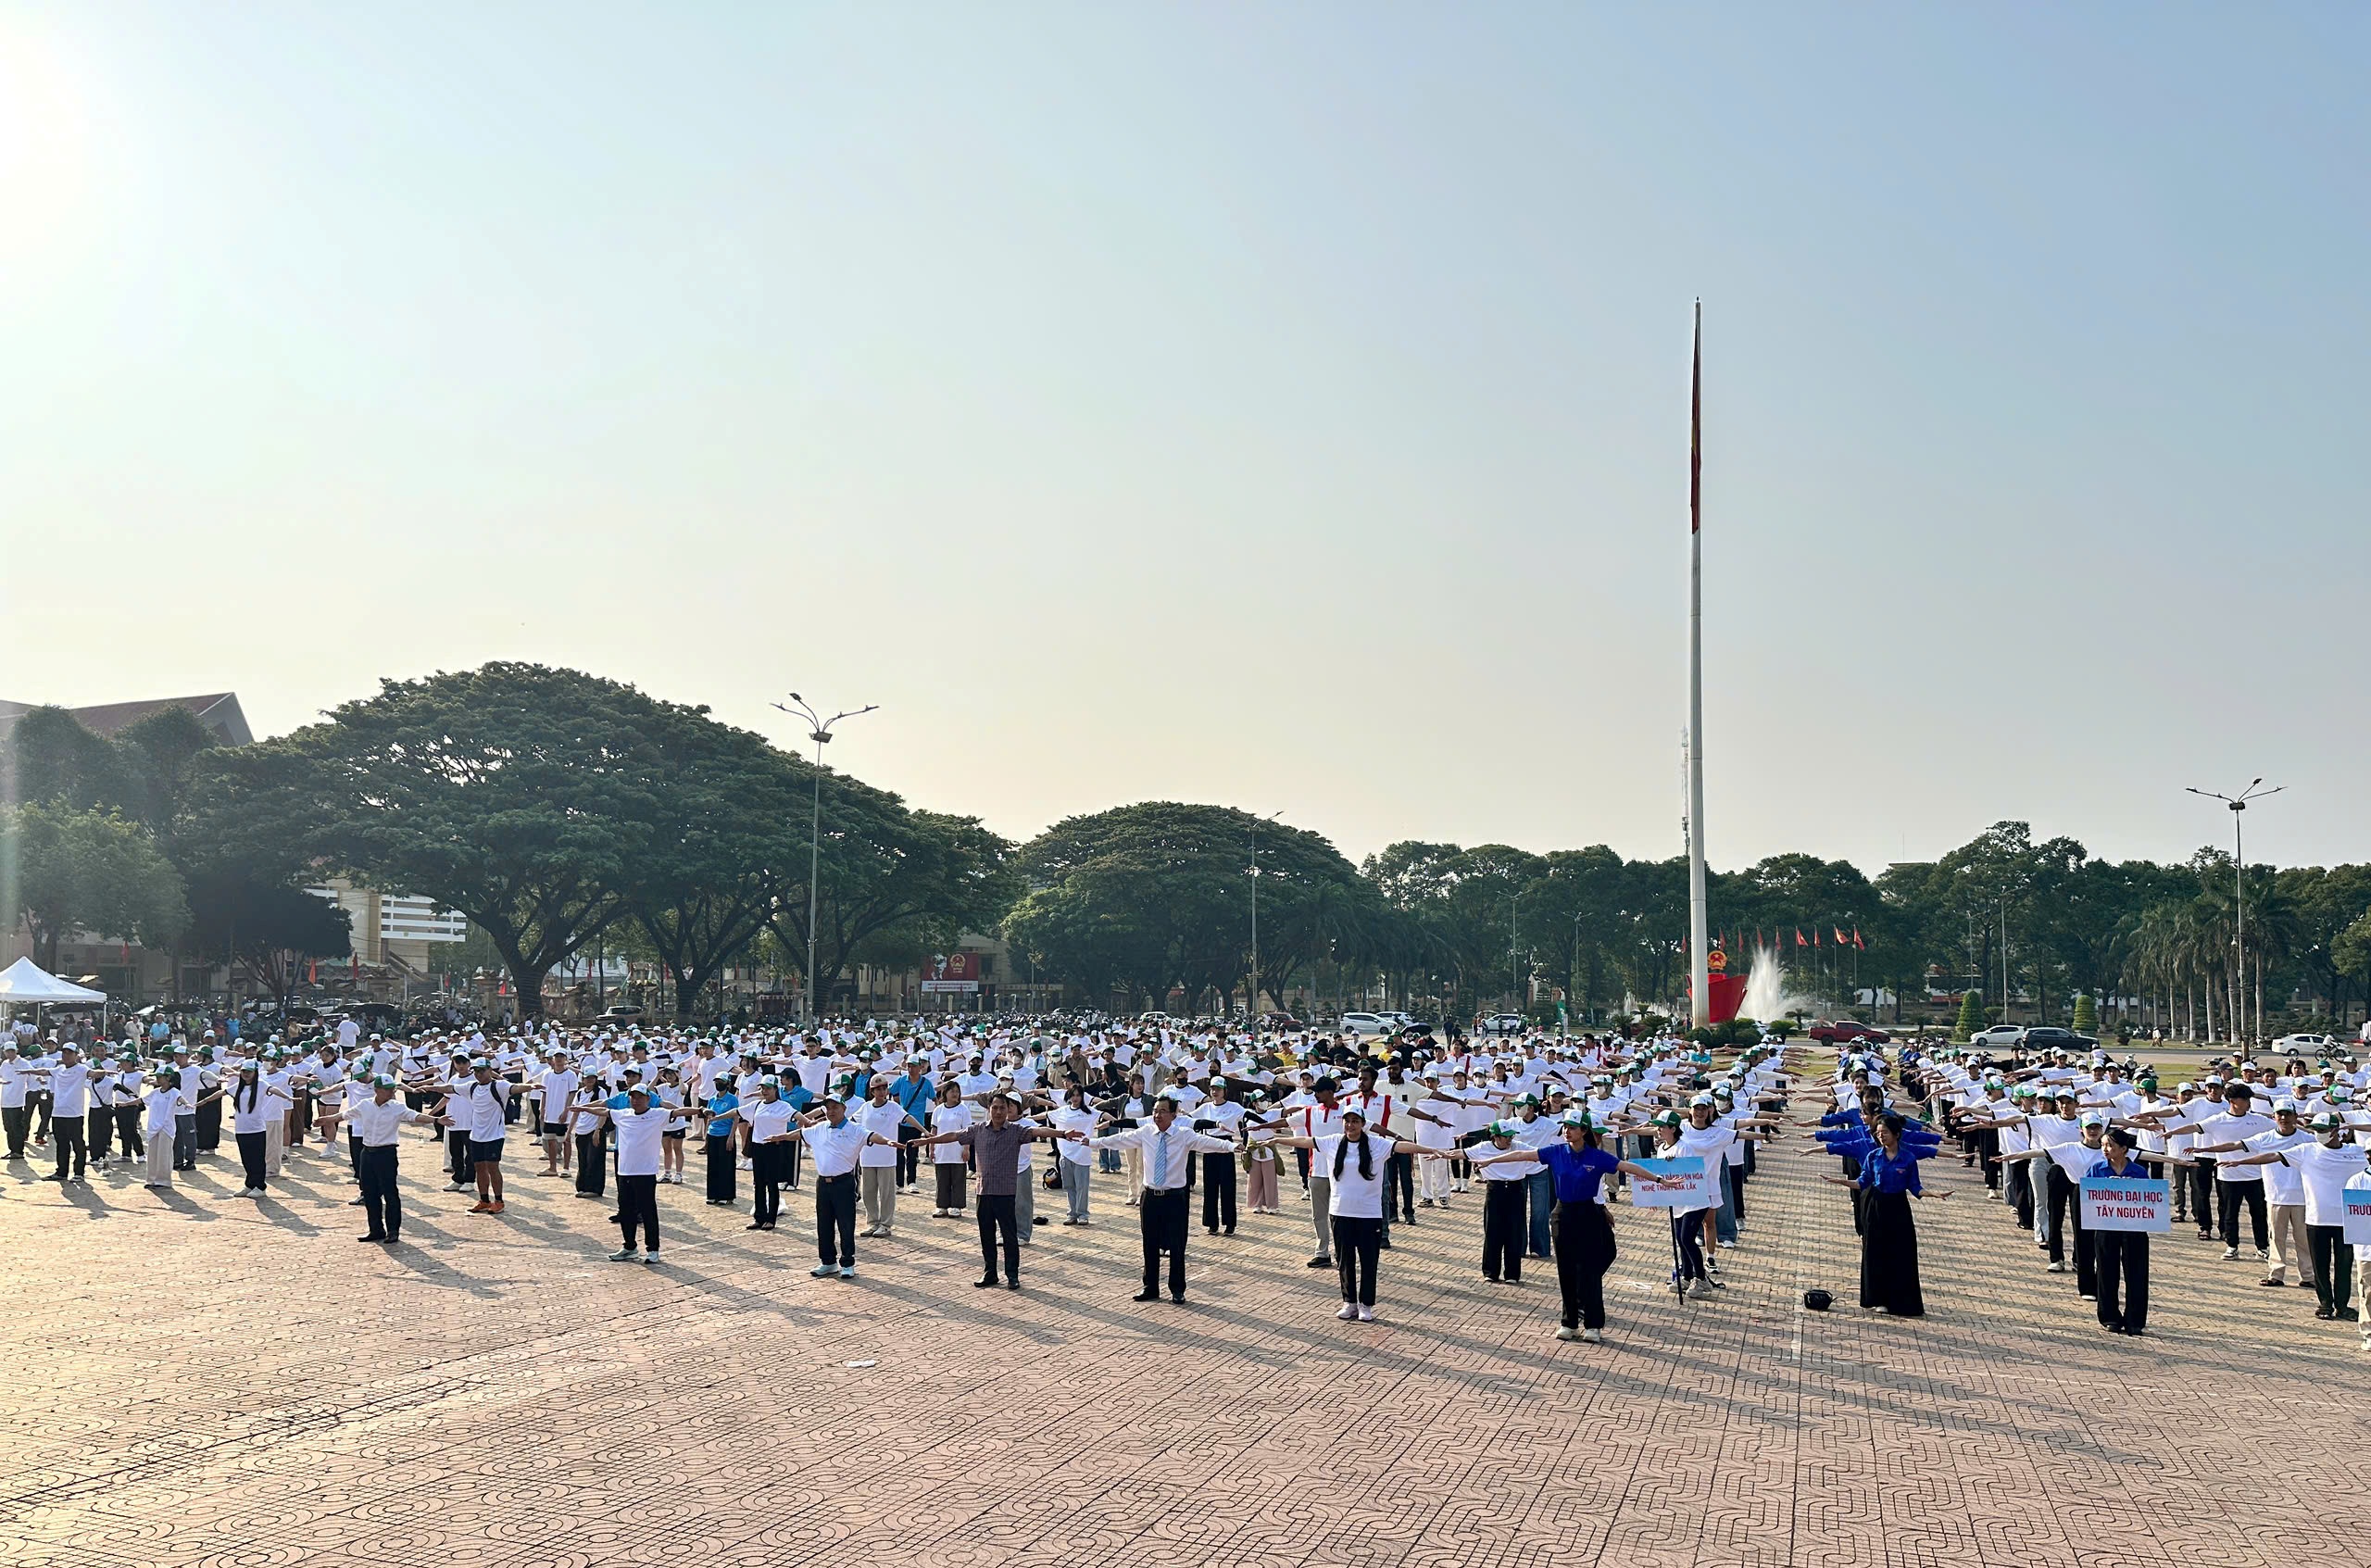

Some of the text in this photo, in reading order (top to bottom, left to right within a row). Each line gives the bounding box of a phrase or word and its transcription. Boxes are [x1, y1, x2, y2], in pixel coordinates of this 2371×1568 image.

[2087, 1188, 2163, 1204] TRƯỜNG ĐẠI HỌC
[2096, 1205, 2155, 1219] TÂY NGUYÊN
